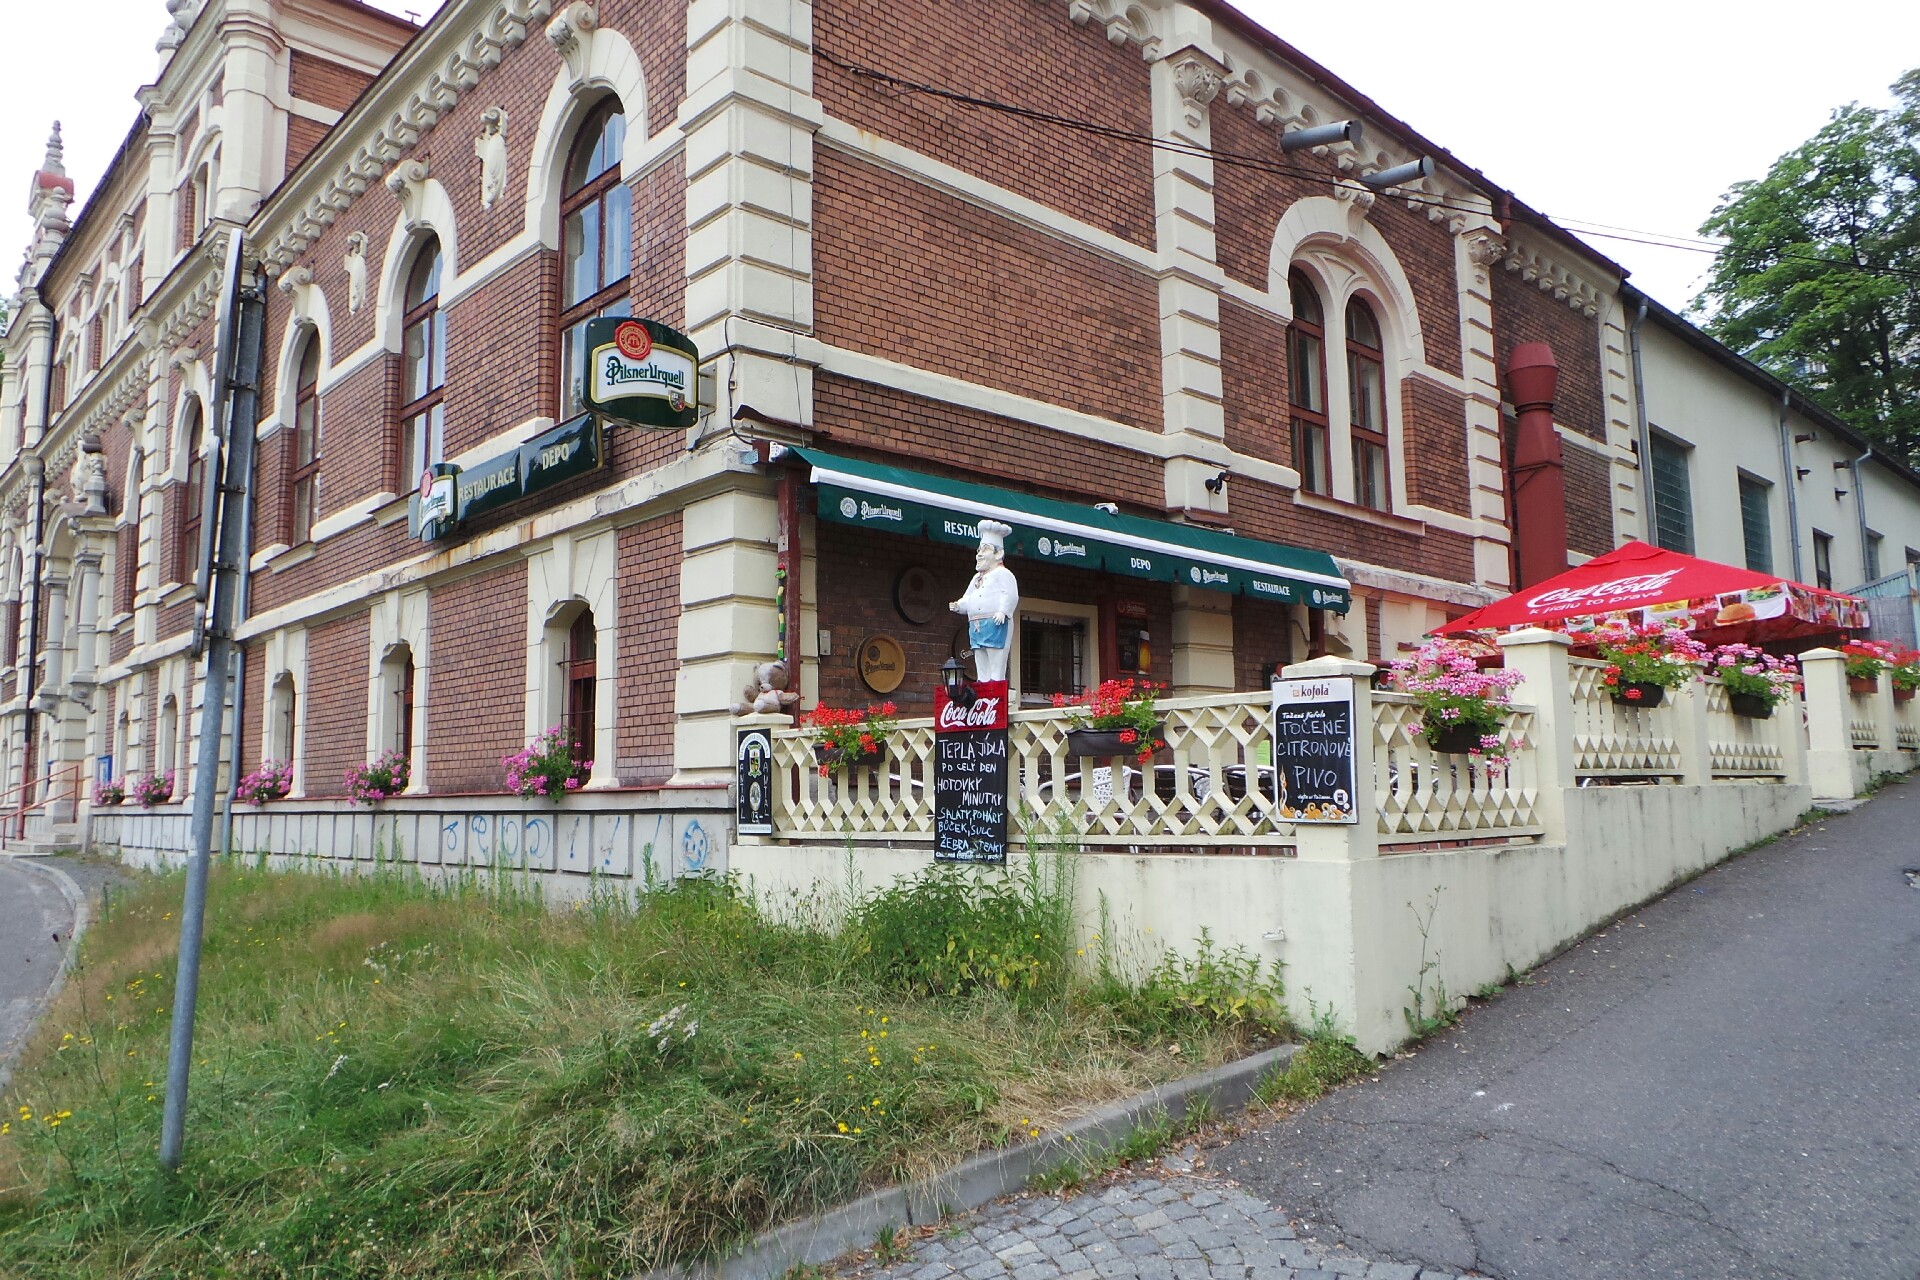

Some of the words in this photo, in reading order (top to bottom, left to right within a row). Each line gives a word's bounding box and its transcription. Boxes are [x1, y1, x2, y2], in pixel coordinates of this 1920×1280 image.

[605, 356, 649, 386] Pilsner
[648, 362, 685, 388] Urquell
[542, 443, 570, 470] DEPO
[458, 466, 516, 502] RESTAURACE
[861, 501, 882, 520] Pilsner
[881, 504, 903, 520] Urquell
[944, 520, 983, 539] RESTAU
[1130, 557, 1151, 571] DEPO
[1252, 580, 1290, 596] RESTAURACE
[1301, 684, 1329, 700] kofola
[1280, 712, 1347, 736] TOČENÉ
[938, 734, 976, 760] TEPLÁ
[975, 732, 1006, 758] JÍDLA
[1277, 737, 1351, 758] CITRONOVÉ
[941, 762, 953, 773] PO
[956, 759, 976, 772] CELÝ
[979, 762, 997, 774] DEN
[937, 776, 983, 794] HOTOVKY
[1294, 765, 1337, 788] PIVO
[962, 790, 1004, 806] MINUTKY
